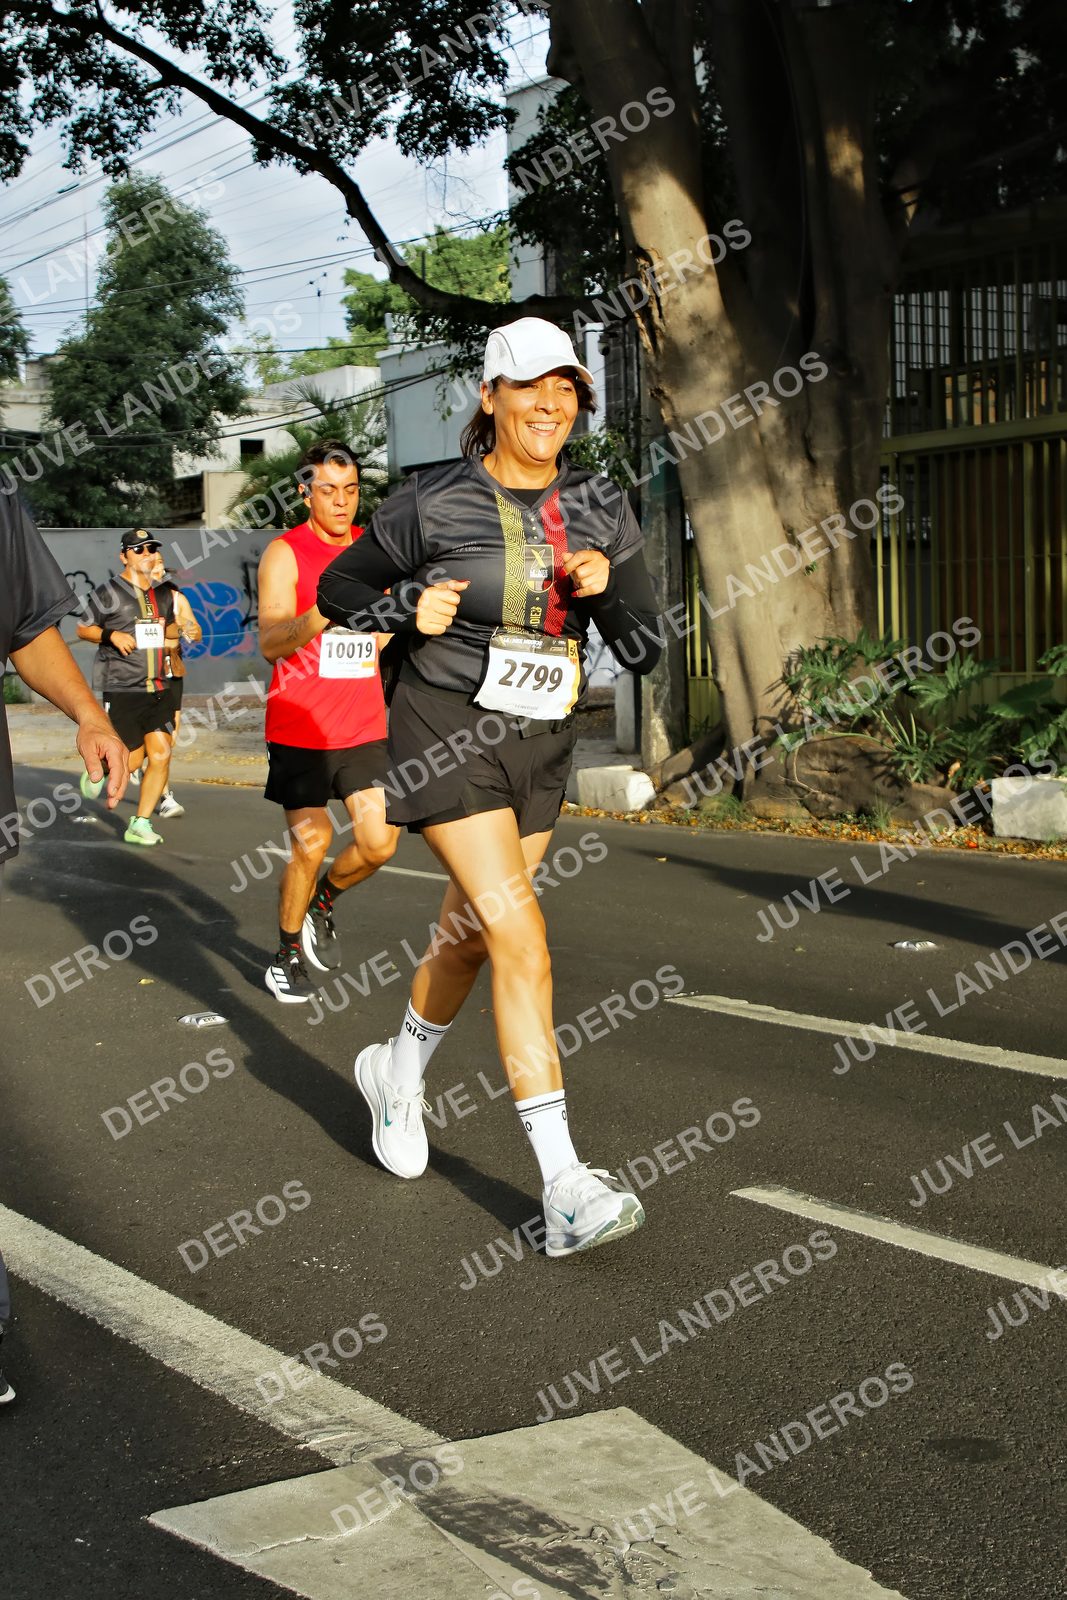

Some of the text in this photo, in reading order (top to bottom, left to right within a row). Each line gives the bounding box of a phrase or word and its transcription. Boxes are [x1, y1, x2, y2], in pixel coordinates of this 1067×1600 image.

[326, 641, 373, 658] 10019
[498, 659, 563, 692] 2799
[405, 1021, 427, 1041] alo
